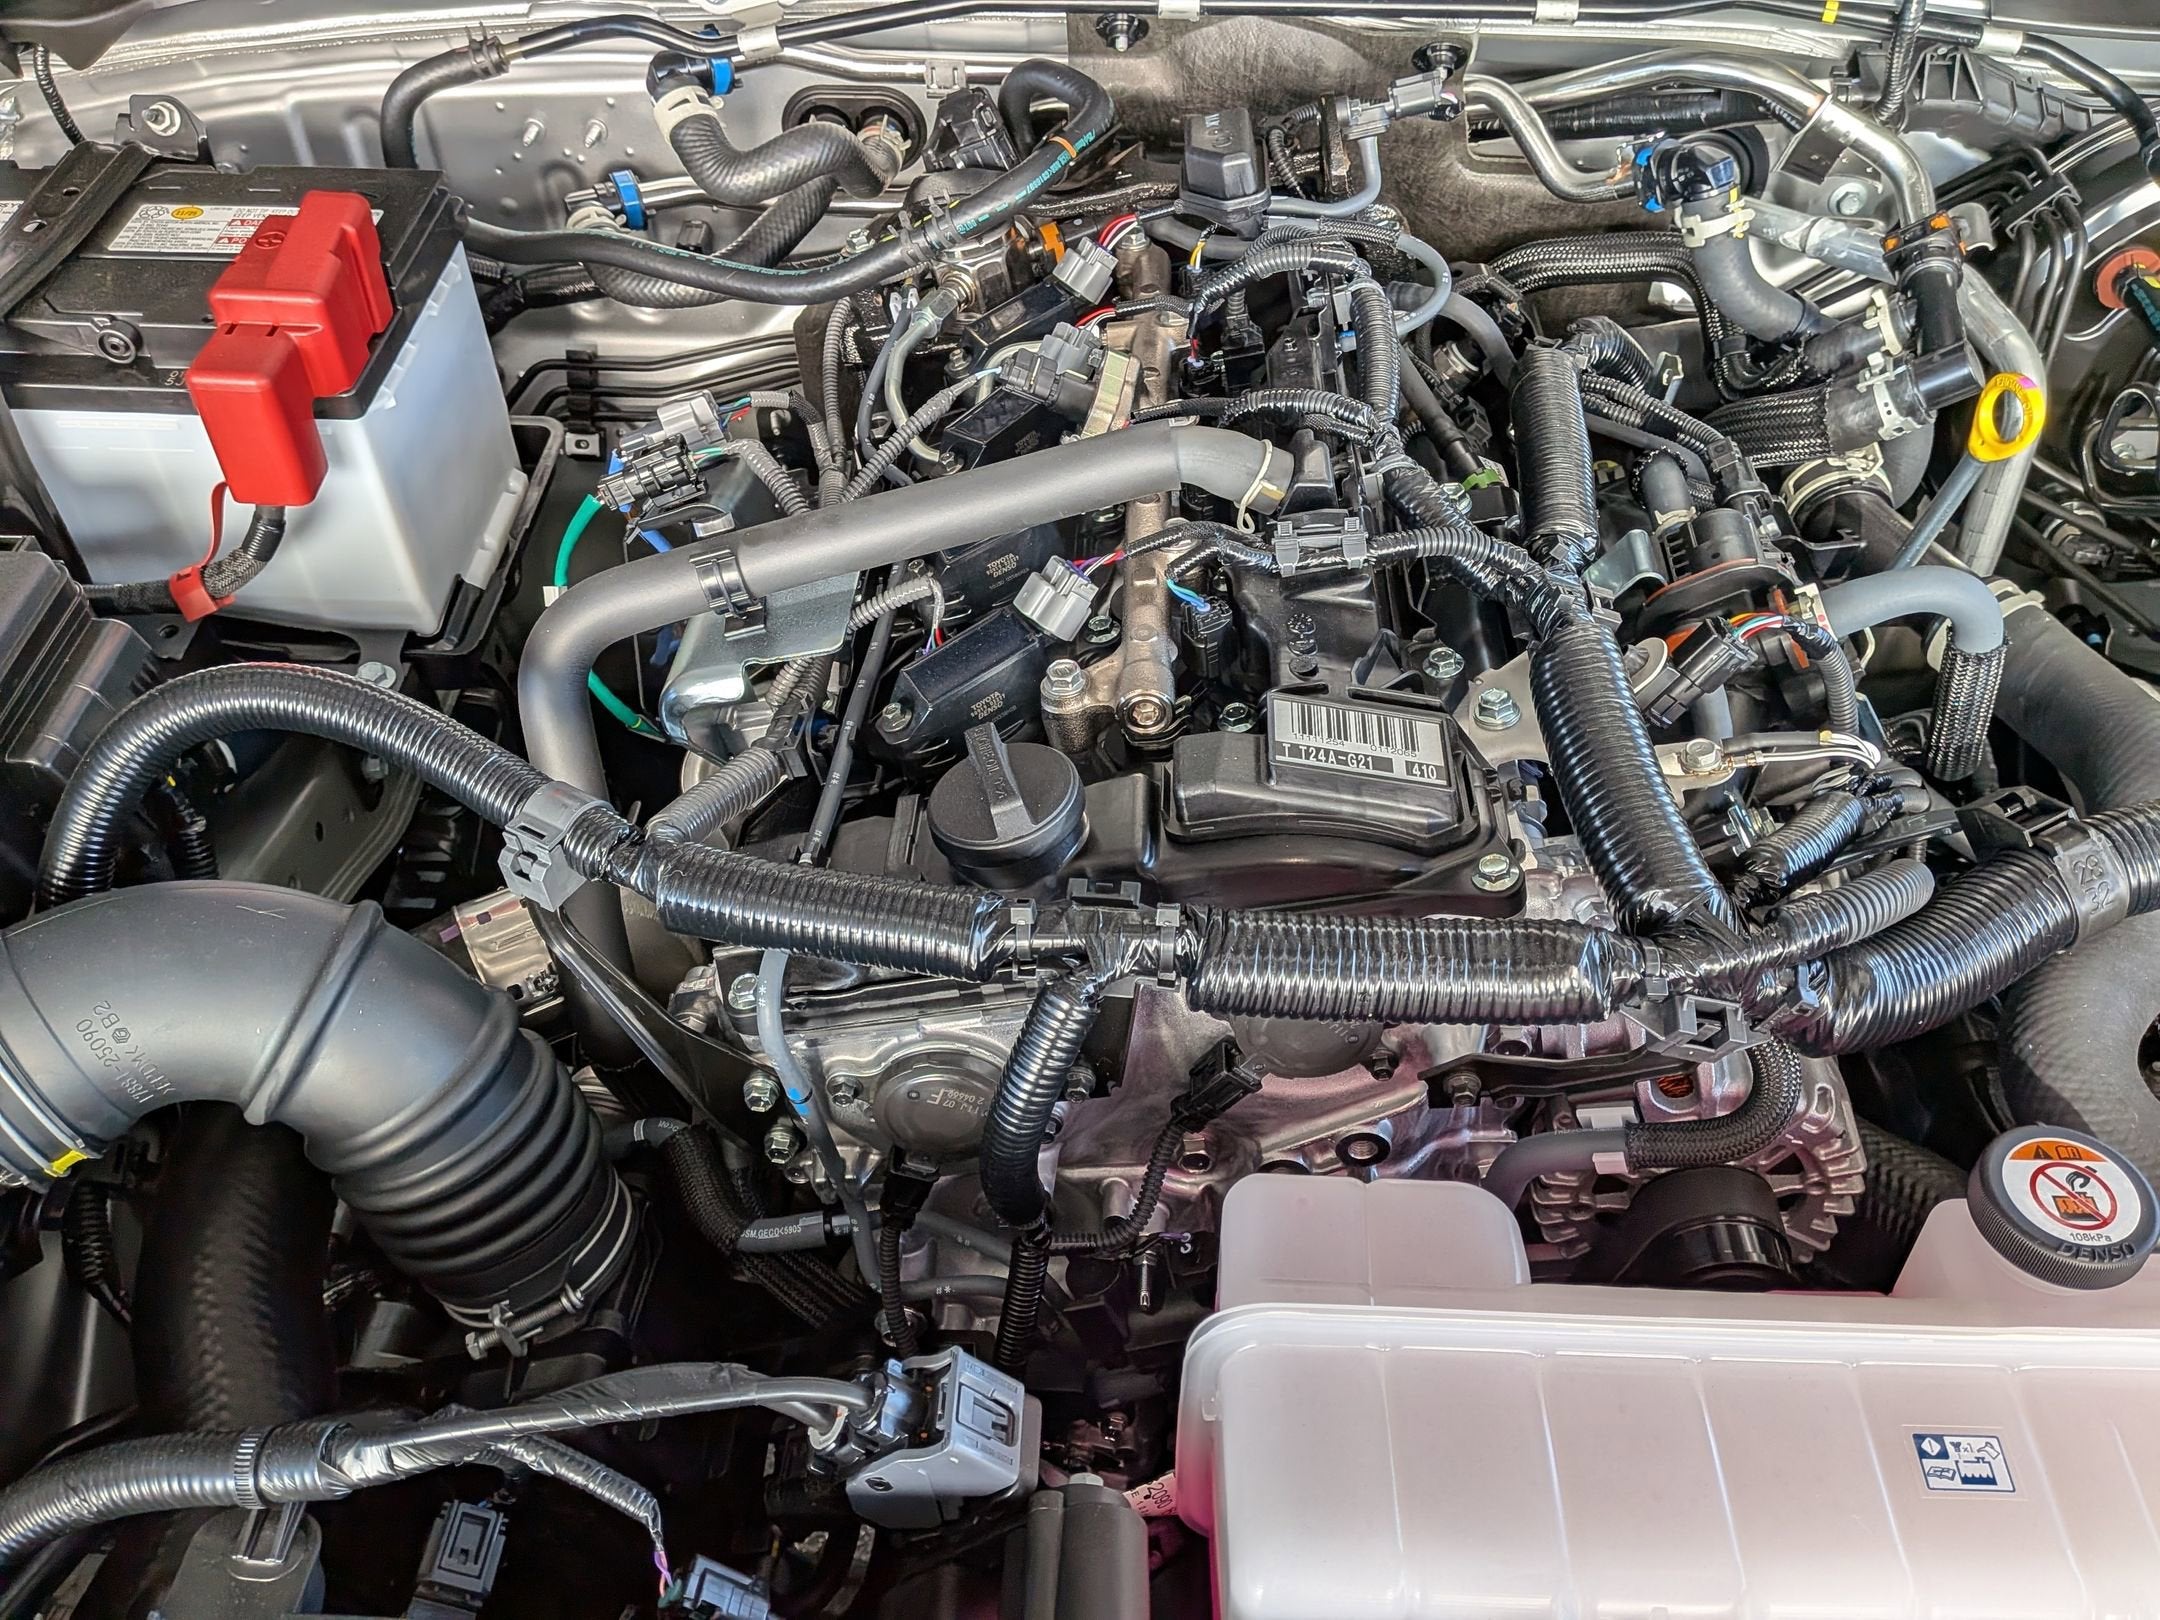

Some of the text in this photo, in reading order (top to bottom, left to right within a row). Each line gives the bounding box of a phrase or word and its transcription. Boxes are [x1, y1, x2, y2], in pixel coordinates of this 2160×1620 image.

[987, 553, 1016, 569] TOYOTA
[993, 562, 1017, 578] DENSO
[970, 691, 1001, 711] TOYOTA
[978, 700, 1003, 720] DENSO
[1282, 743, 1438, 780] T T24A-G21 410
[2073, 854, 2104, 886] 28
[2069, 1232, 2113, 1243] 108kPa
[2056, 1242, 2137, 1263] DENSO
